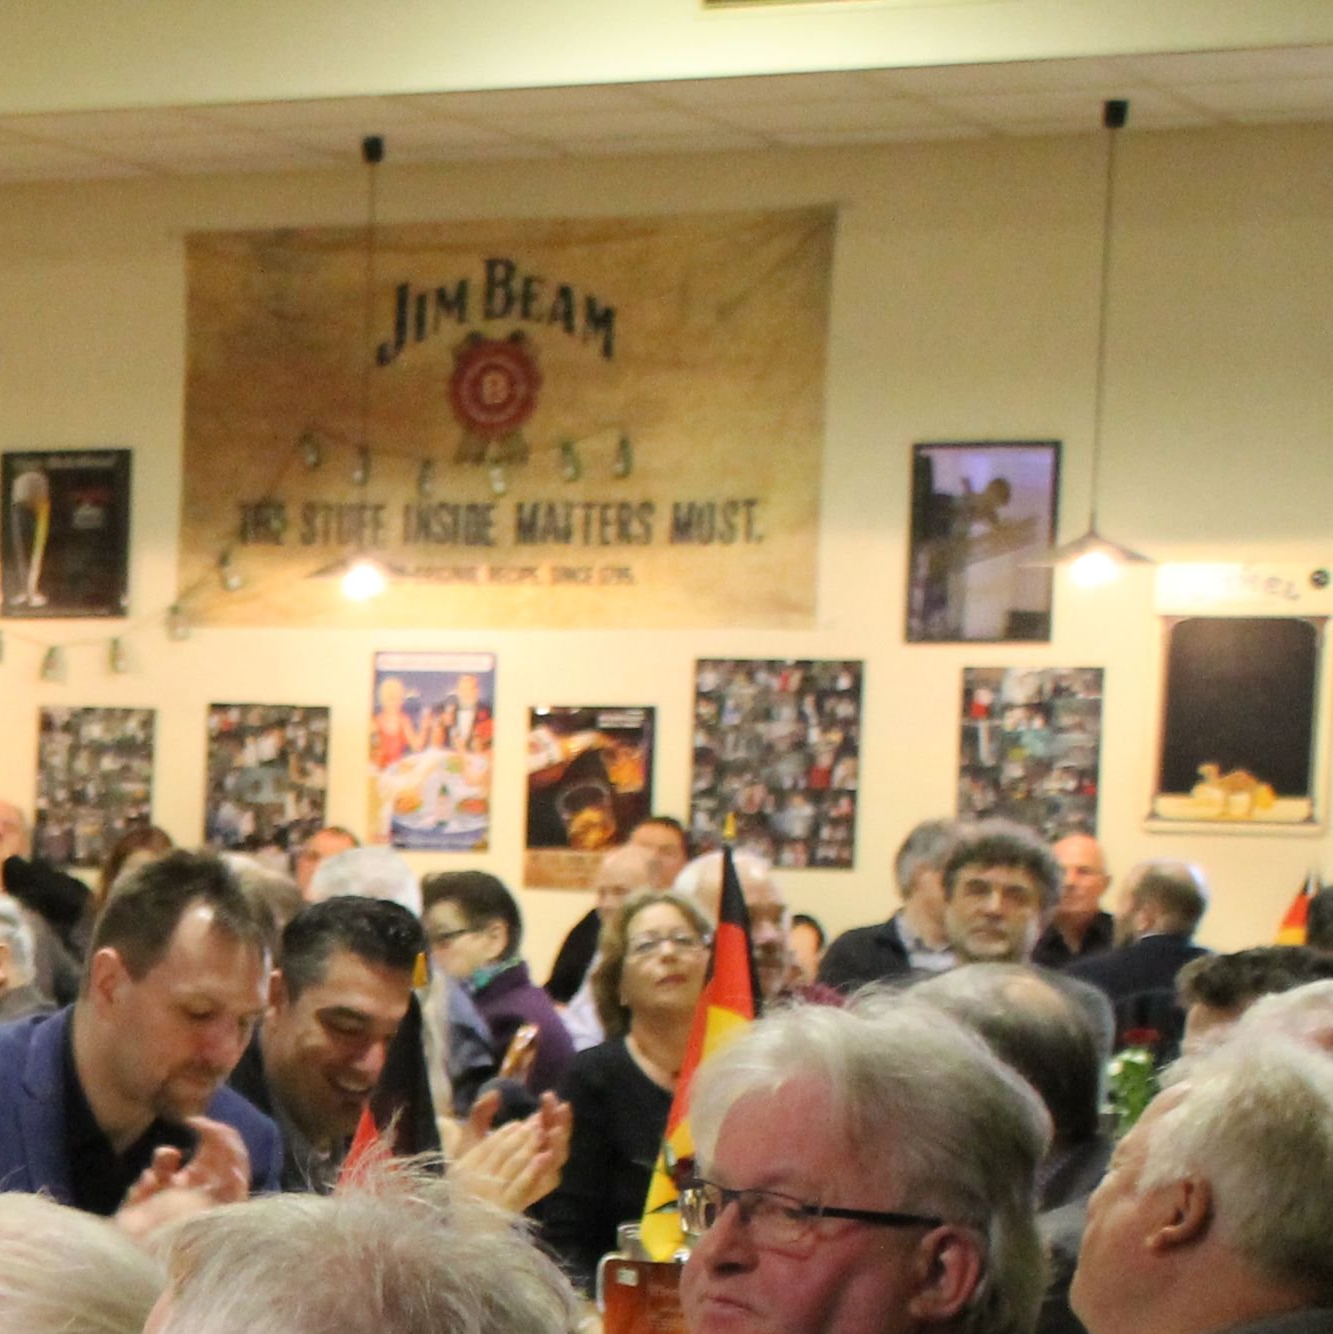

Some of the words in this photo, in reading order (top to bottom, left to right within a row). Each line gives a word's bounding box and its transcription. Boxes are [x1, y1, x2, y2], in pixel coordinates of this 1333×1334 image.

[376, 280, 469, 368] JIM
[483, 256, 617, 362] BEAM
[403, 501, 497, 547] INSIDE
[515, 499, 654, 546] MATTERS
